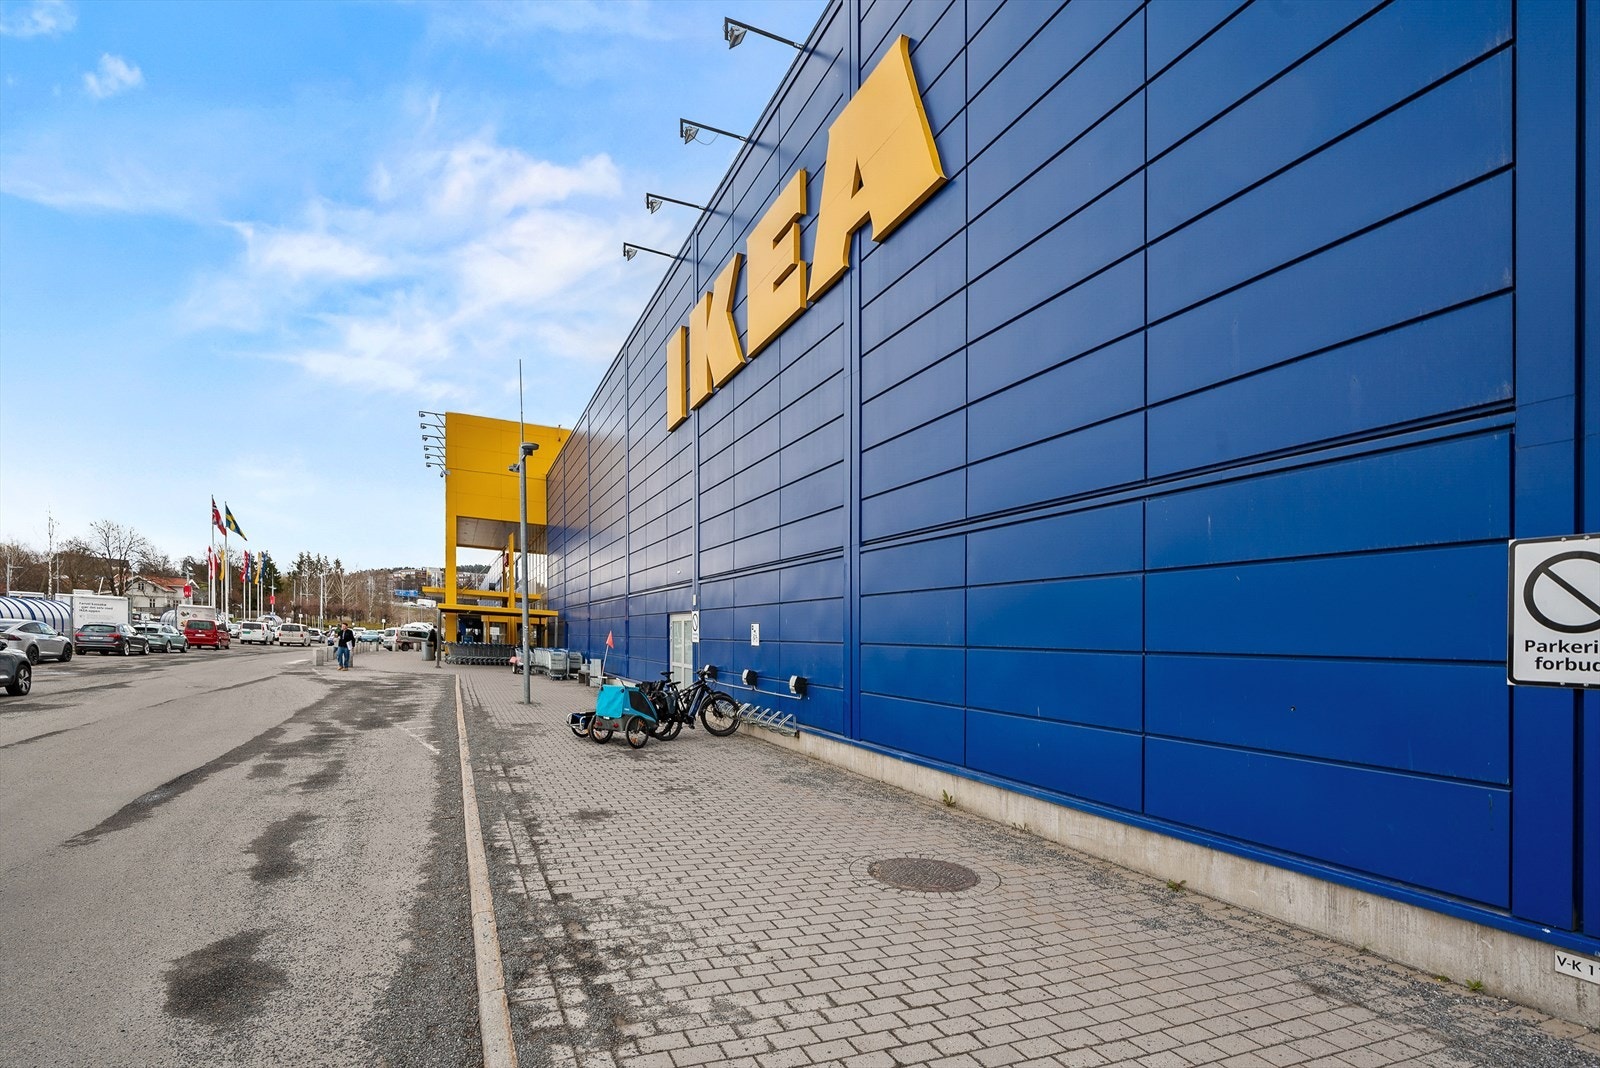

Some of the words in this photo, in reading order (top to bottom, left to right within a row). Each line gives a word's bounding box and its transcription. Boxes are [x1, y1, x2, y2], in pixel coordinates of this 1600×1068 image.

[666, 34, 947, 432] IKEA
[1525, 640, 1598, 654] Parkeri
[1557, 955, 1582, 972] V-K
